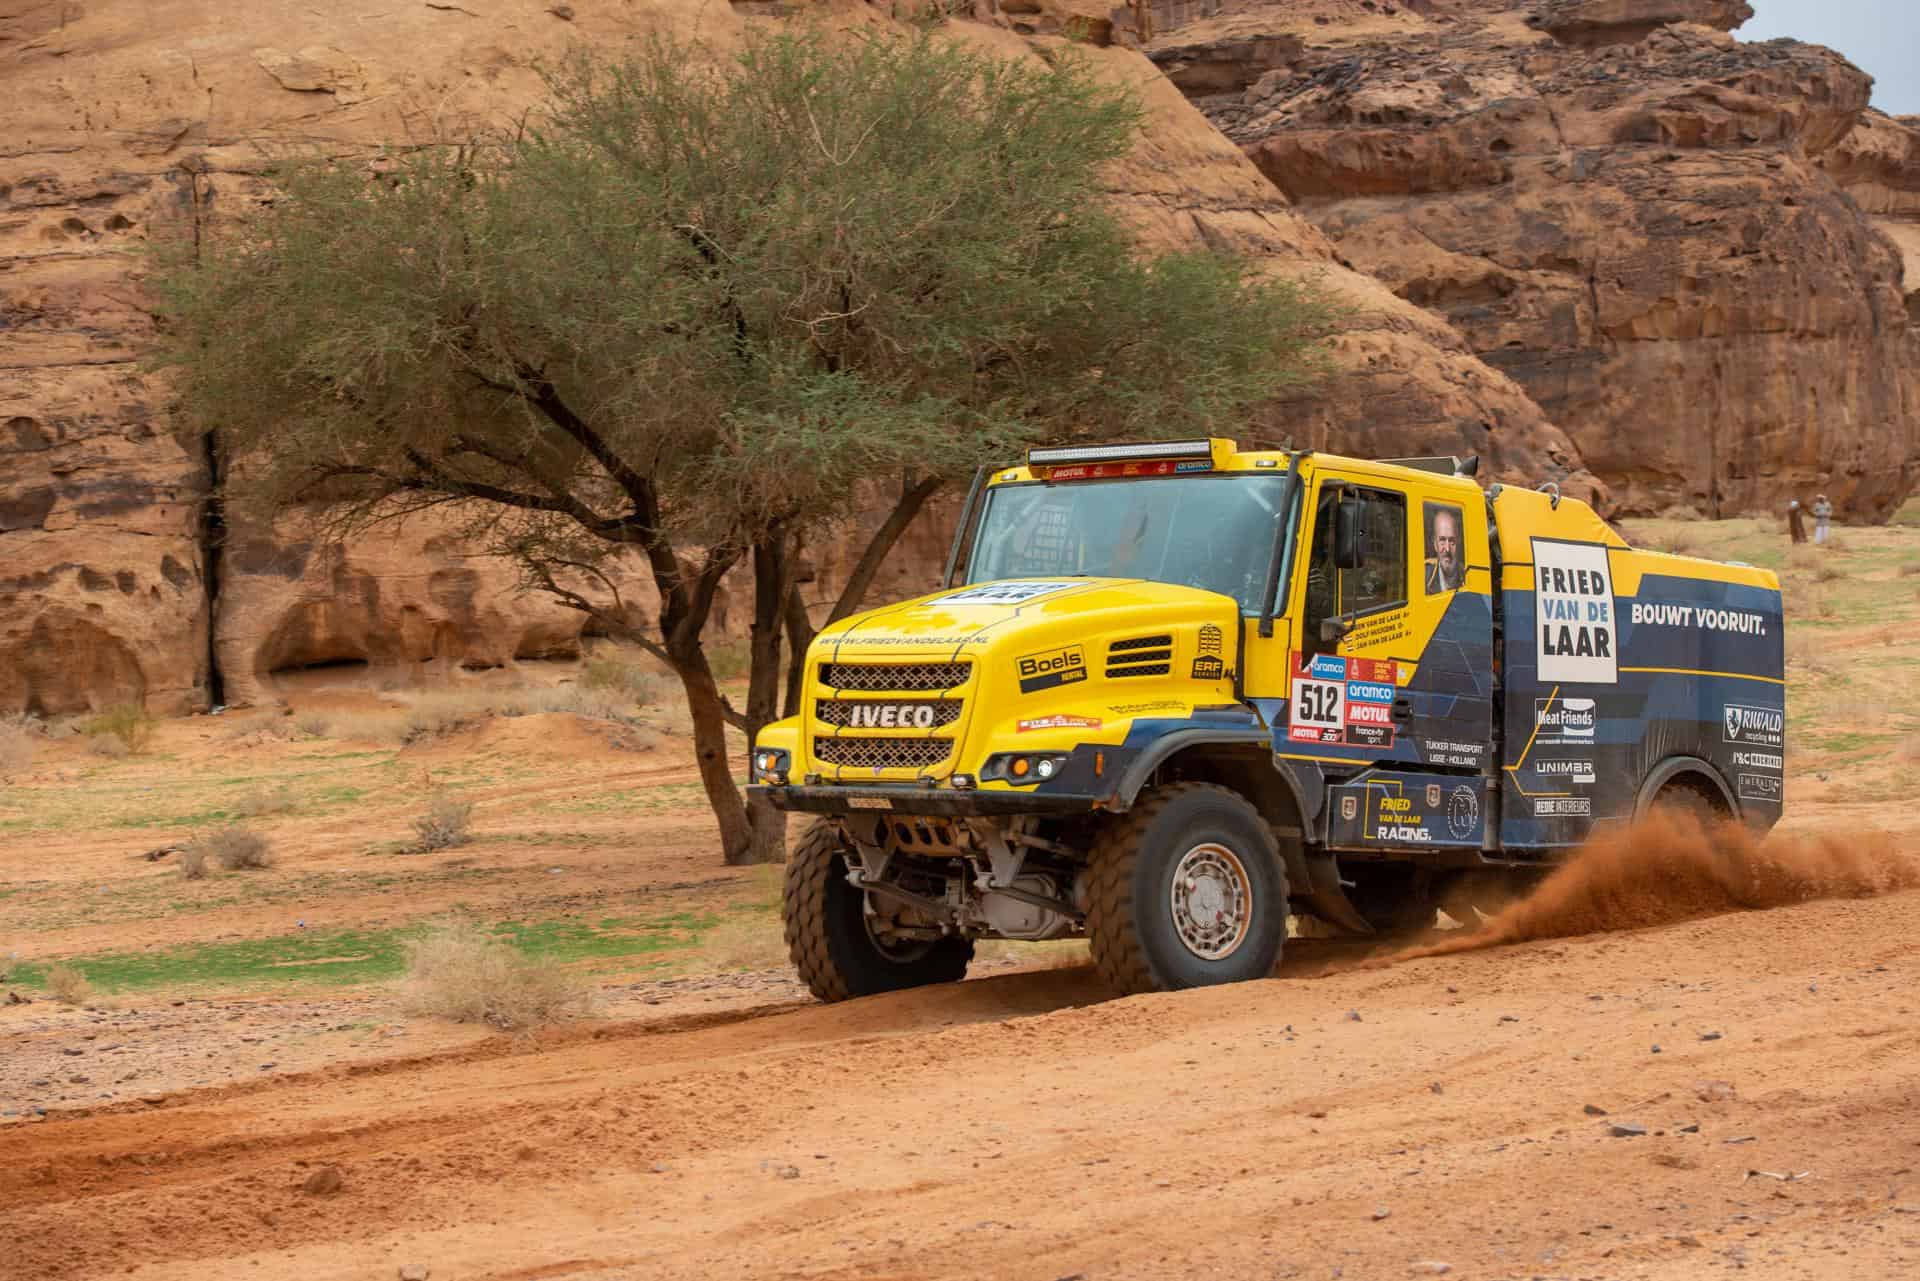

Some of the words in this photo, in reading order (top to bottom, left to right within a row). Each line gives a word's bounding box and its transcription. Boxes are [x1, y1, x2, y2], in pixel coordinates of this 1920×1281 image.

[1054, 466, 1086, 478] MOTUL
[1540, 567, 1605, 595] FRIED
[1543, 599, 1579, 621] VAN
[1587, 601, 1608, 622] DE
[1632, 603, 1692, 627] BOUWT
[1696, 608, 1766, 636] VOORUIT.
[1543, 624, 1611, 658] LAAR
[1020, 651, 1081, 675] Boels
[1195, 661, 1221, 671] ERF
[1315, 662, 1344, 673] aramco
[1349, 684, 1392, 699] aramco
[1300, 684, 1338, 722] 512
[851, 705, 933, 728] IVECO
[1349, 705, 1390, 722] MOTUL
[1537, 710, 1559, 725] Meat
[1561, 710, 1593, 725] Friends
[1742, 710, 1781, 732] RIWALD
[1293, 727, 1319, 739] MOTUL
[1425, 740, 1448, 752] TUKKER
[1449, 742, 1483, 754] TRANSPORT
[1449, 755, 1477, 766] HOLLAND
[1380, 798, 1411, 811] FRIED
[1379, 814, 1393, 823] VAN
[1403, 815, 1422, 824] LAAR
[1377, 826, 1432, 841] RACING.
